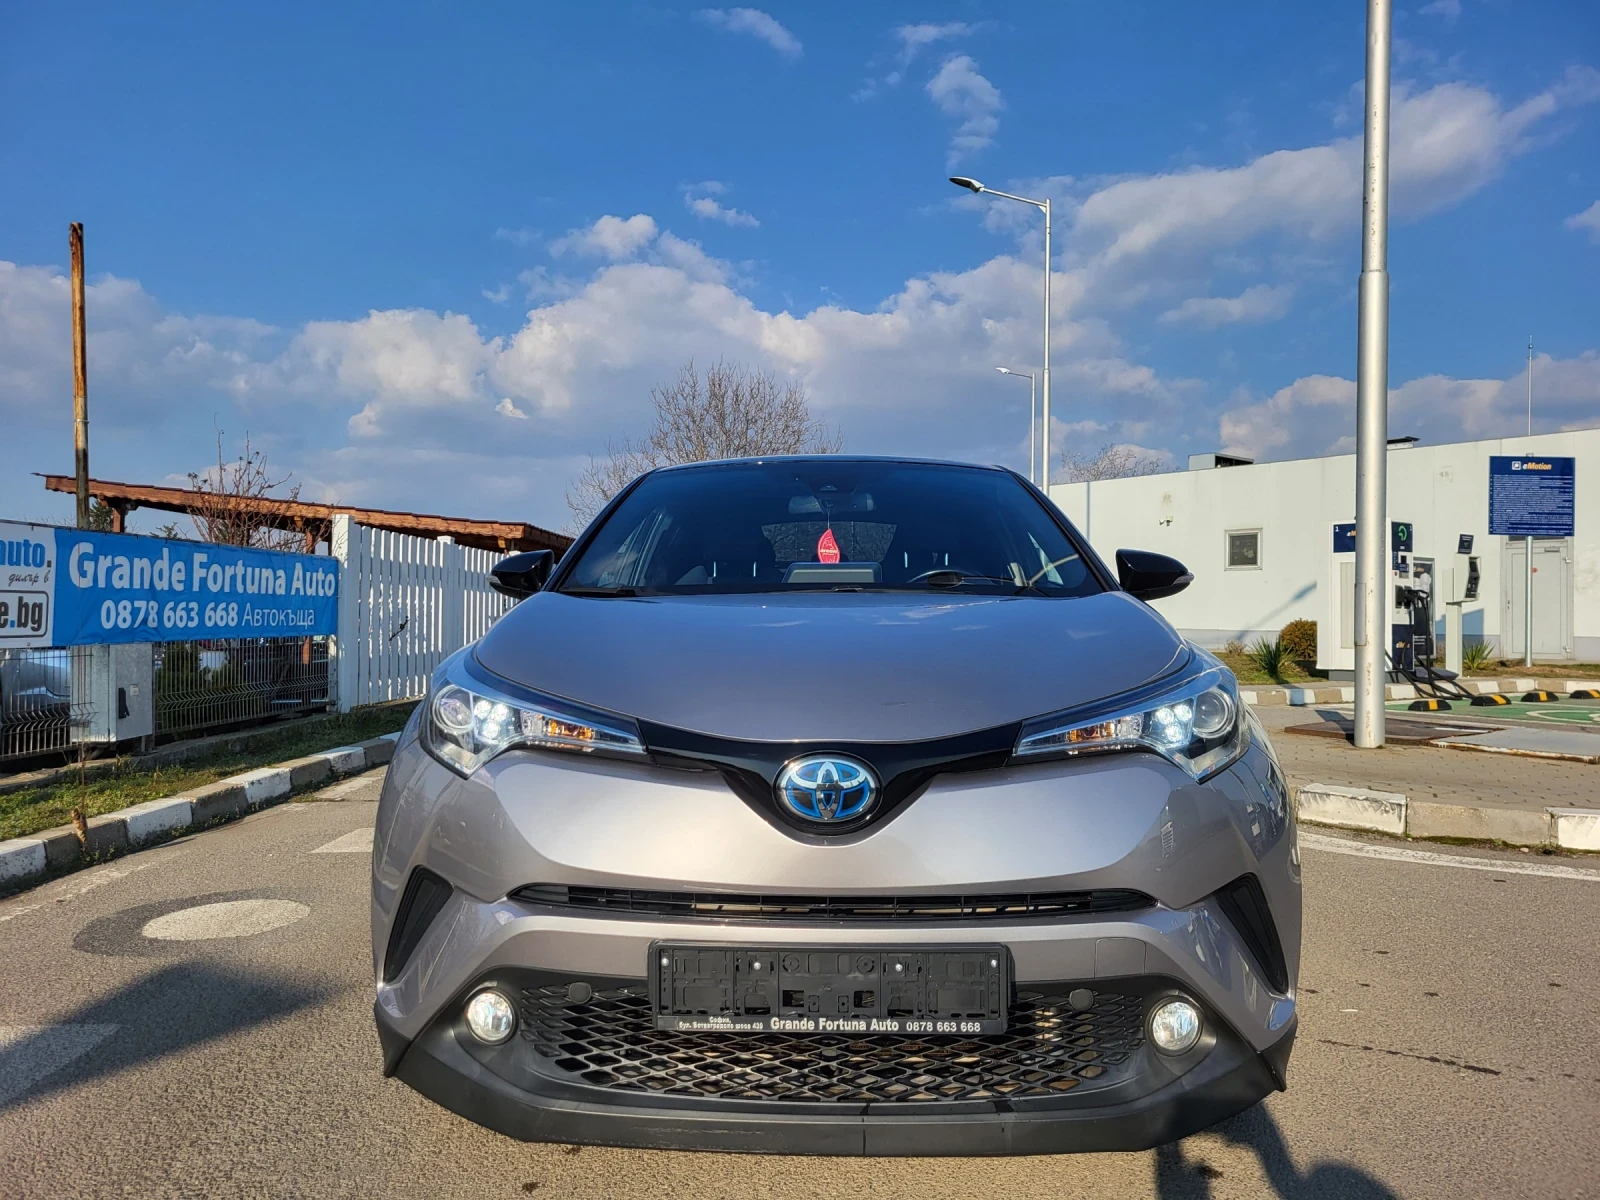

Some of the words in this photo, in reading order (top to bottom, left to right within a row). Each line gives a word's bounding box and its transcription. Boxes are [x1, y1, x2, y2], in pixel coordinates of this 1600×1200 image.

[1522, 461, 1552, 470] eMotion
[69, 541, 186, 592] Grande
[192, 552, 286, 595] Fortuna
[290, 562, 336, 597] Auto
[101, 599, 159, 629] 0878
[163, 601, 199, 628] 663
[204, 602, 238, 627] 668
[241, 602, 315, 629] Автокъща
[770, 1017, 815, 1030] Grande
[819, 1018, 866, 1031] Fortuna
[870, 1018, 899, 1031] Auto
[906, 1021, 933, 1032] 0878
[936, 1022, 957, 1032] 663
[960, 1022, 981, 1032] 668
